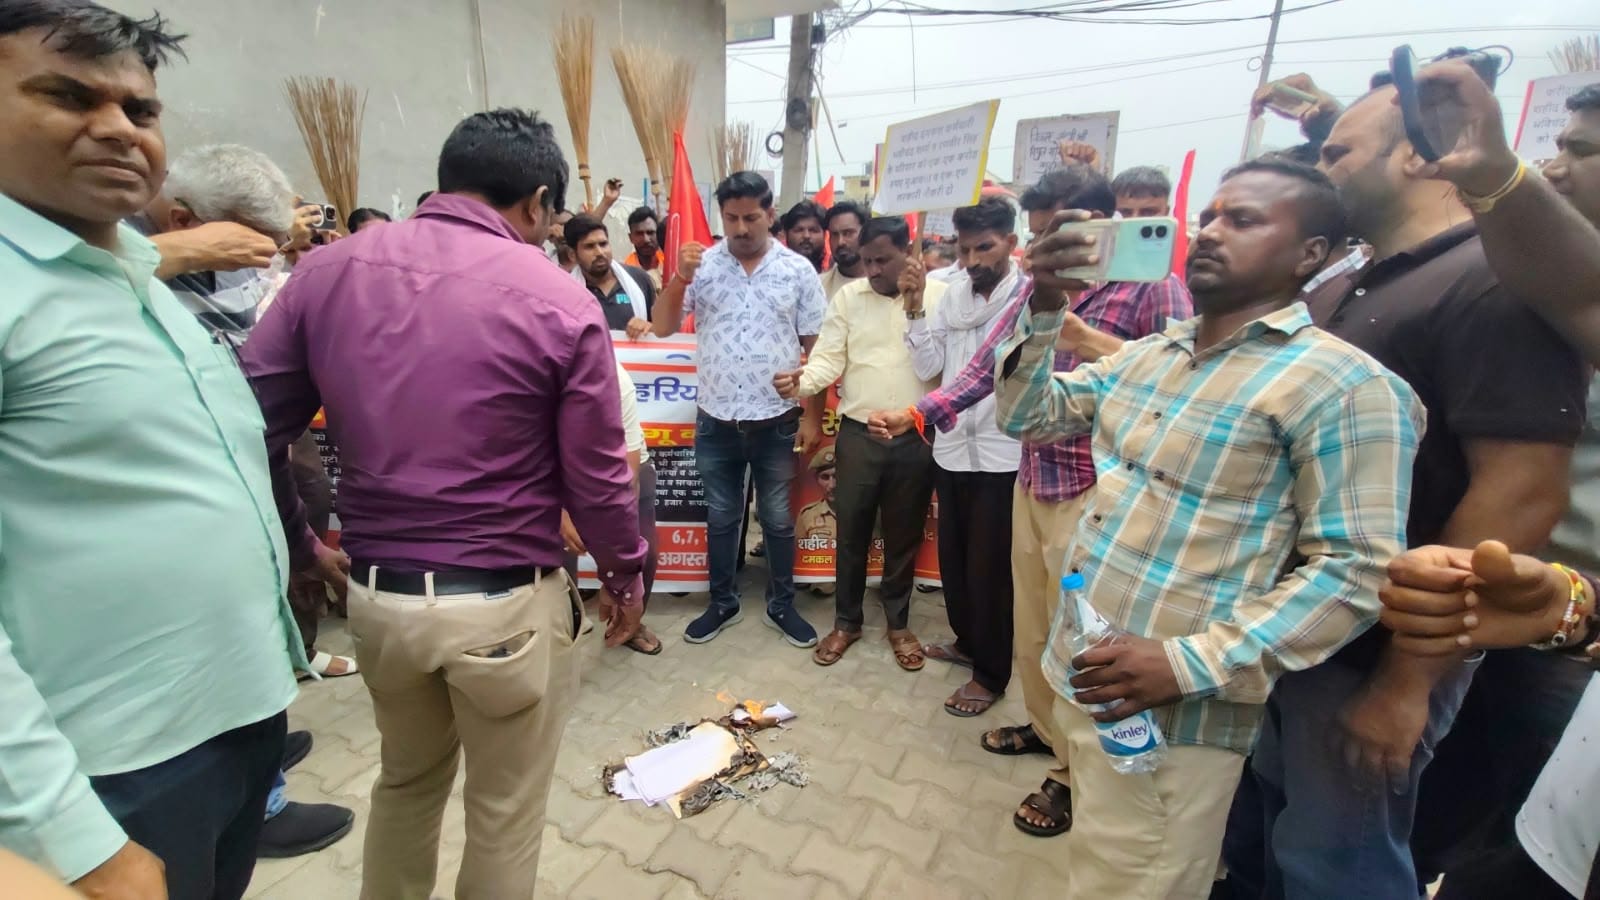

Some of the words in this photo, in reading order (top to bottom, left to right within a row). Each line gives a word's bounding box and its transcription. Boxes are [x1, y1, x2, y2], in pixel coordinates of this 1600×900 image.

[633, 376, 698, 402] हरिय
[798, 533, 828, 550] शहीद
[657, 551, 709, 567] अगस्त
[801, 554, 833, 564] दमकल
[1111, 723, 1148, 741] kinley
